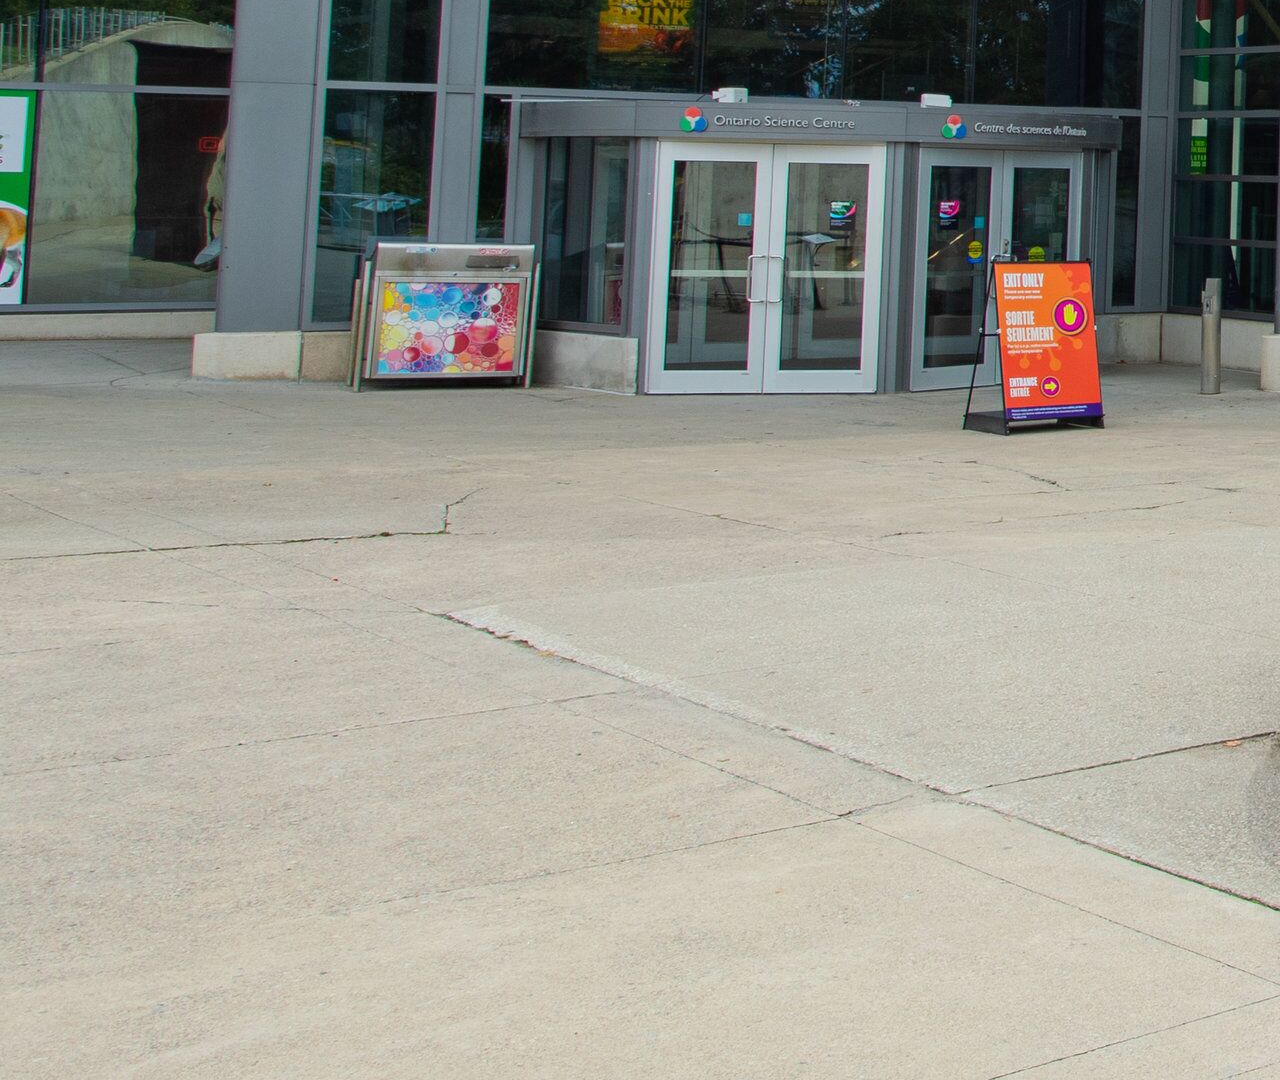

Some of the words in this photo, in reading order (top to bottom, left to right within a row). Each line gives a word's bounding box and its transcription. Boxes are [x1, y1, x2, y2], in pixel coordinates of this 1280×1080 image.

[714, 115, 761, 126] Ontario
[764, 116, 809, 127] Science
[813, 117, 855, 129] Centre
[974, 123, 1004, 133] Centre
[1007, 123, 1020, 133] des
[1021, 126, 1052, 135] sciences
[1053, 126, 1062, 135] de
[1003, 273, 1021, 287] EXIT
[1022, 273, 1044, 287] ONLY
[1006, 311, 1035, 325] SORTIE
[1007, 327, 1054, 342] SEULEMENT
[1009, 377, 1037, 387] ENTRANCE
